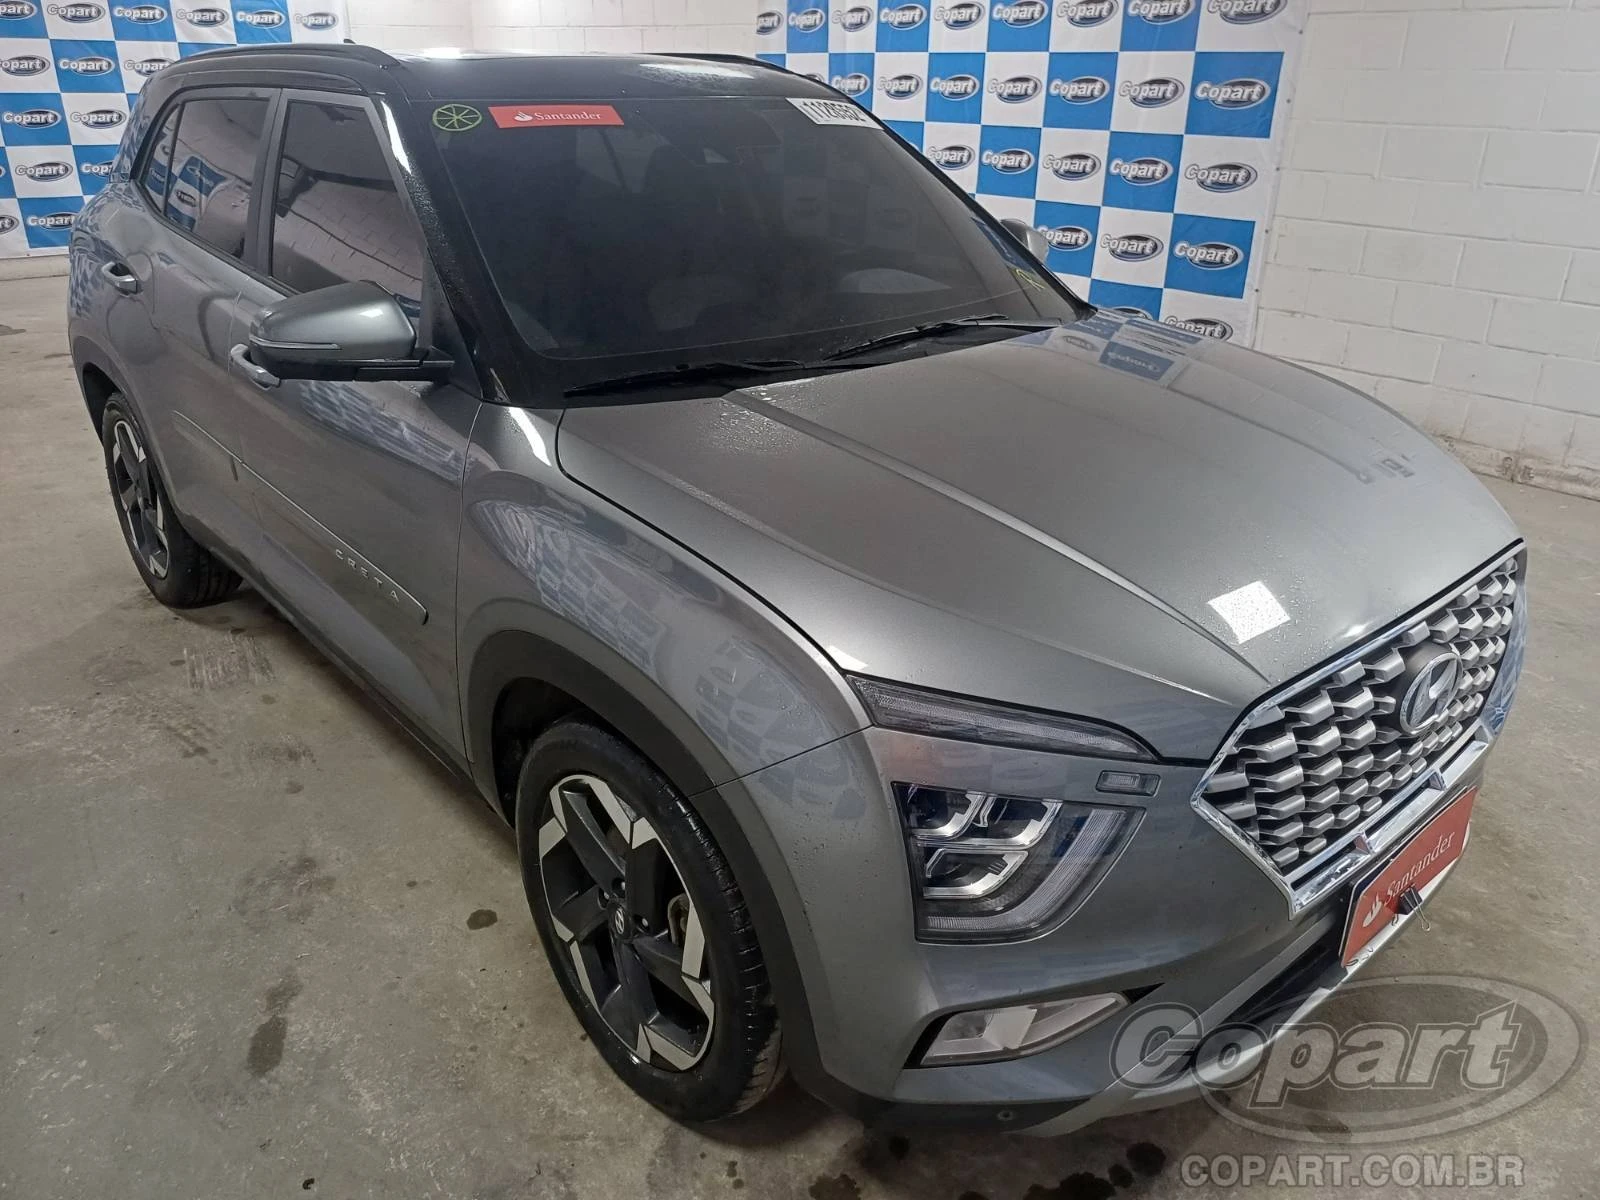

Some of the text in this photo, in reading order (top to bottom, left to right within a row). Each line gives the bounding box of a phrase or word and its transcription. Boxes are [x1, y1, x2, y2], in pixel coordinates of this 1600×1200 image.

[0, 3, 30, 15] part
[47, 4, 97, 17] Copart
[114, 6, 162, 20] Copart
[176, 8, 222, 22] Copart
[880, 8, 920, 25] Copart
[934, 4, 978, 24] Copart
[992, 2, 1040, 21] Copart
[1056, 0, 1110, 20] Copart
[1128, 0, 1187, 19] Copart
[1207, 0, 1275, 16] Copart
[236, 11, 280, 24] Copart
[294, 14, 333, 26] Copart
[789, 12, 820, 29] Copart
[832, 10, 867, 27] Copart
[0, 59, 41, 71] opart
[59, 59, 109, 73] Copart
[832, 75, 865, 93] Copart
[878, 76, 914, 94] Copart
[930, 76, 974, 96] Copart
[987, 78, 1034, 97] Copart
[1050, 78, 1103, 99] Copart
[1119, 80, 1175, 101] Copart
[1195, 82, 1264, 104] Copart
[3, 111, 55, 126] Copart
[71, 111, 119, 126] Copart
[534, 110, 602, 121] Santander
[927, 146, 970, 164] Copart
[981, 150, 1029, 168] Copart
[1042, 154, 1095, 174] Copart
[15, 164, 66, 177] Copart
[1109, 158, 1166, 179] Copart
[1185, 163, 1248, 185] Copart
[1100, 234, 1155, 254] Copart
[1174, 242, 1234, 264] Copart
[335, 548, 400, 603] CRETA
[1383, 831, 1456, 907] Santander
